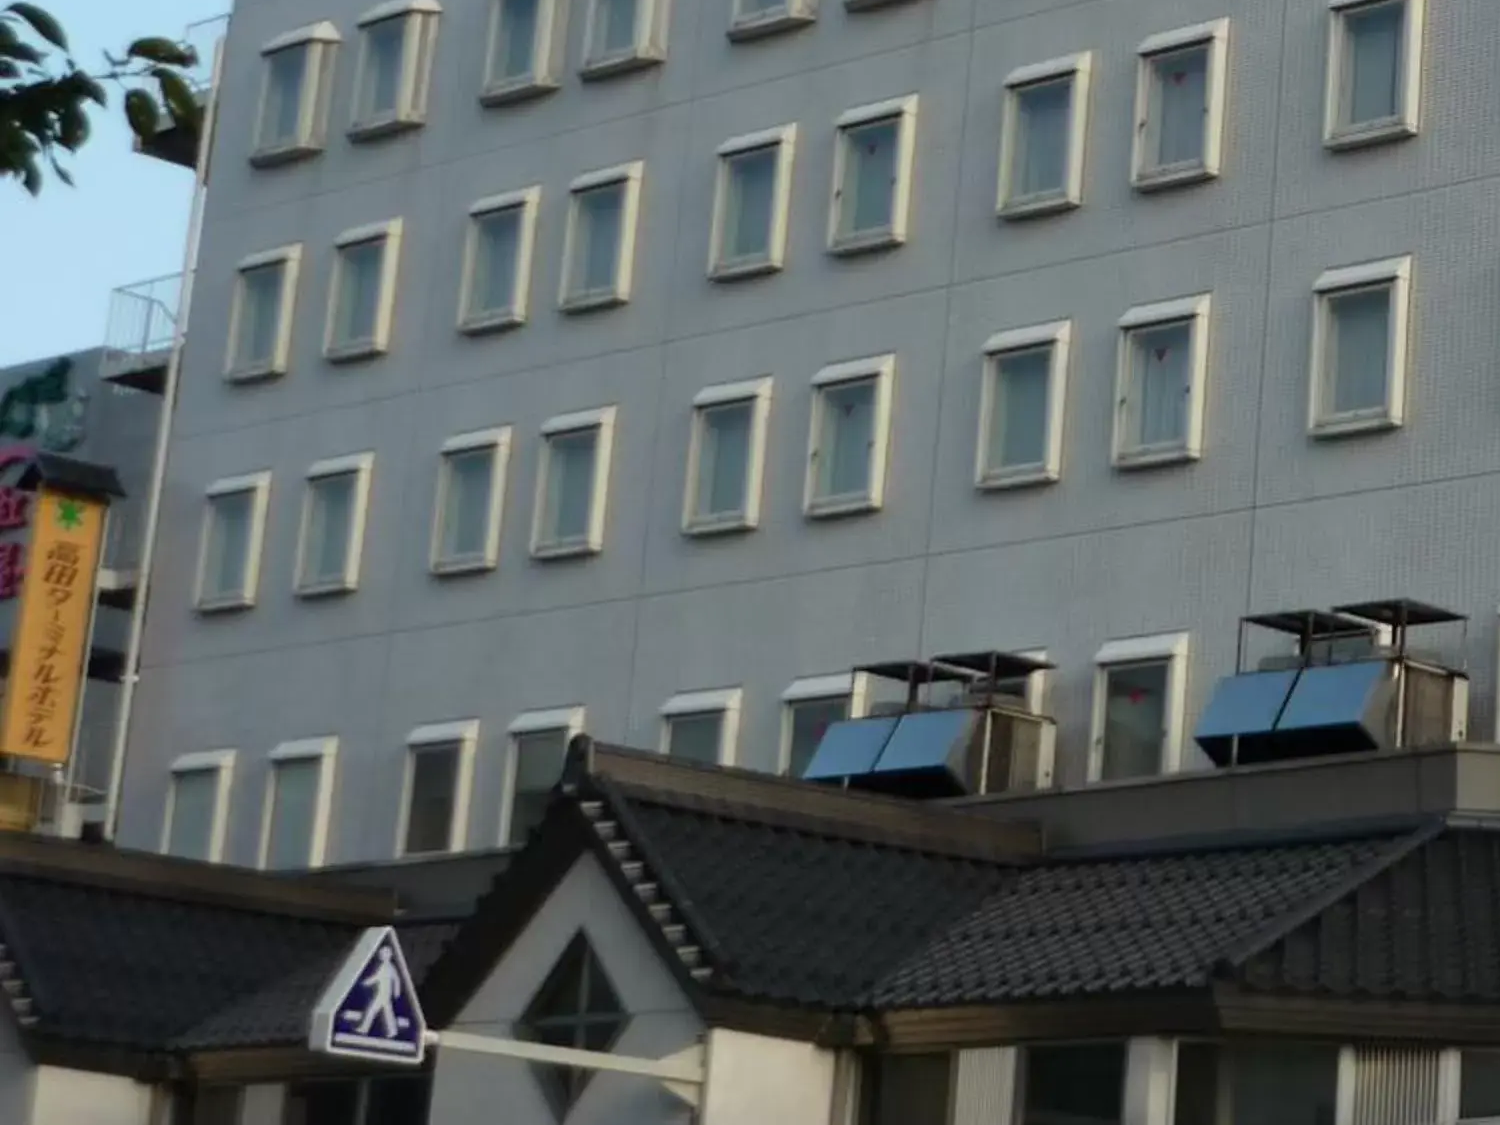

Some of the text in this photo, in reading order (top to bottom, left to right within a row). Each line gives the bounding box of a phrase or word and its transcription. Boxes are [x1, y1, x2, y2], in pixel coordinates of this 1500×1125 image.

[23, 539, 86, 748] 高田ターミナルホテル
